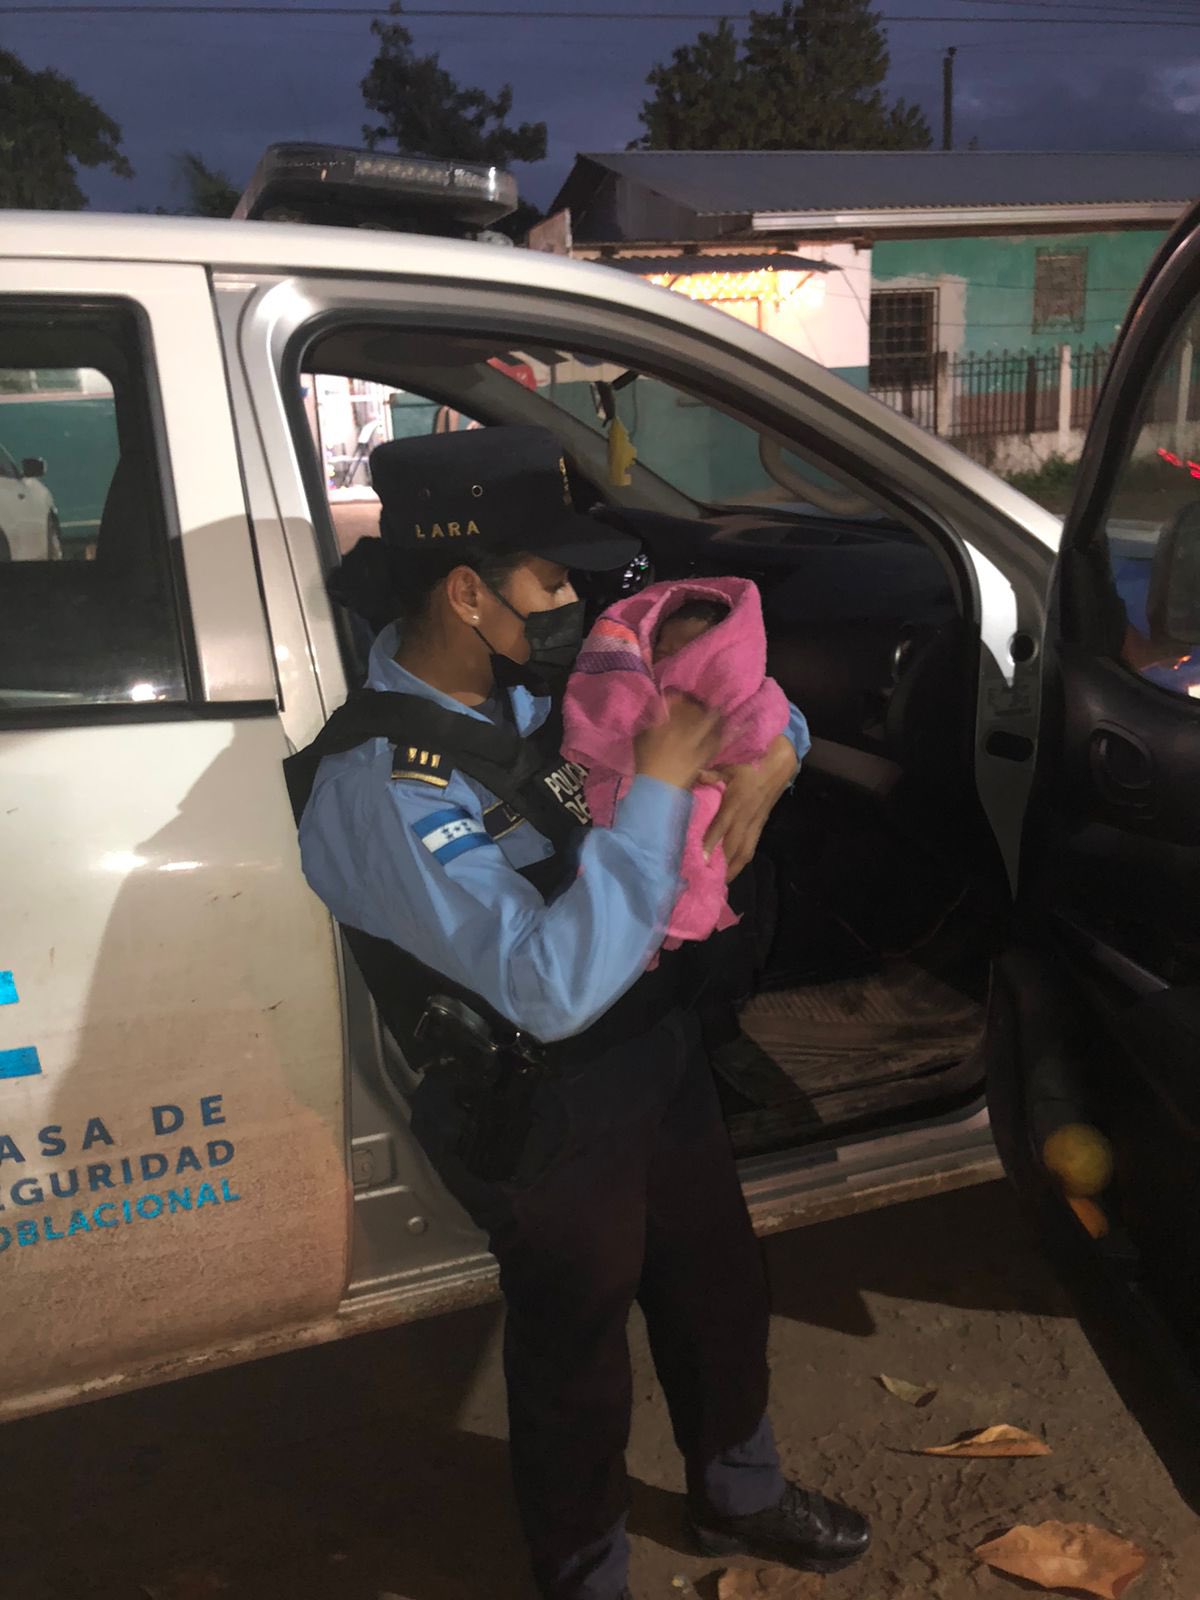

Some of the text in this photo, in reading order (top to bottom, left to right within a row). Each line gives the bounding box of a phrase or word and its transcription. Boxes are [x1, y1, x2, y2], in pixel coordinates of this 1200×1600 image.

[415, 520, 480, 539] LARA
[152, 1094, 226, 1136] DE
[0, 1139, 235, 1211] GURIDAD
